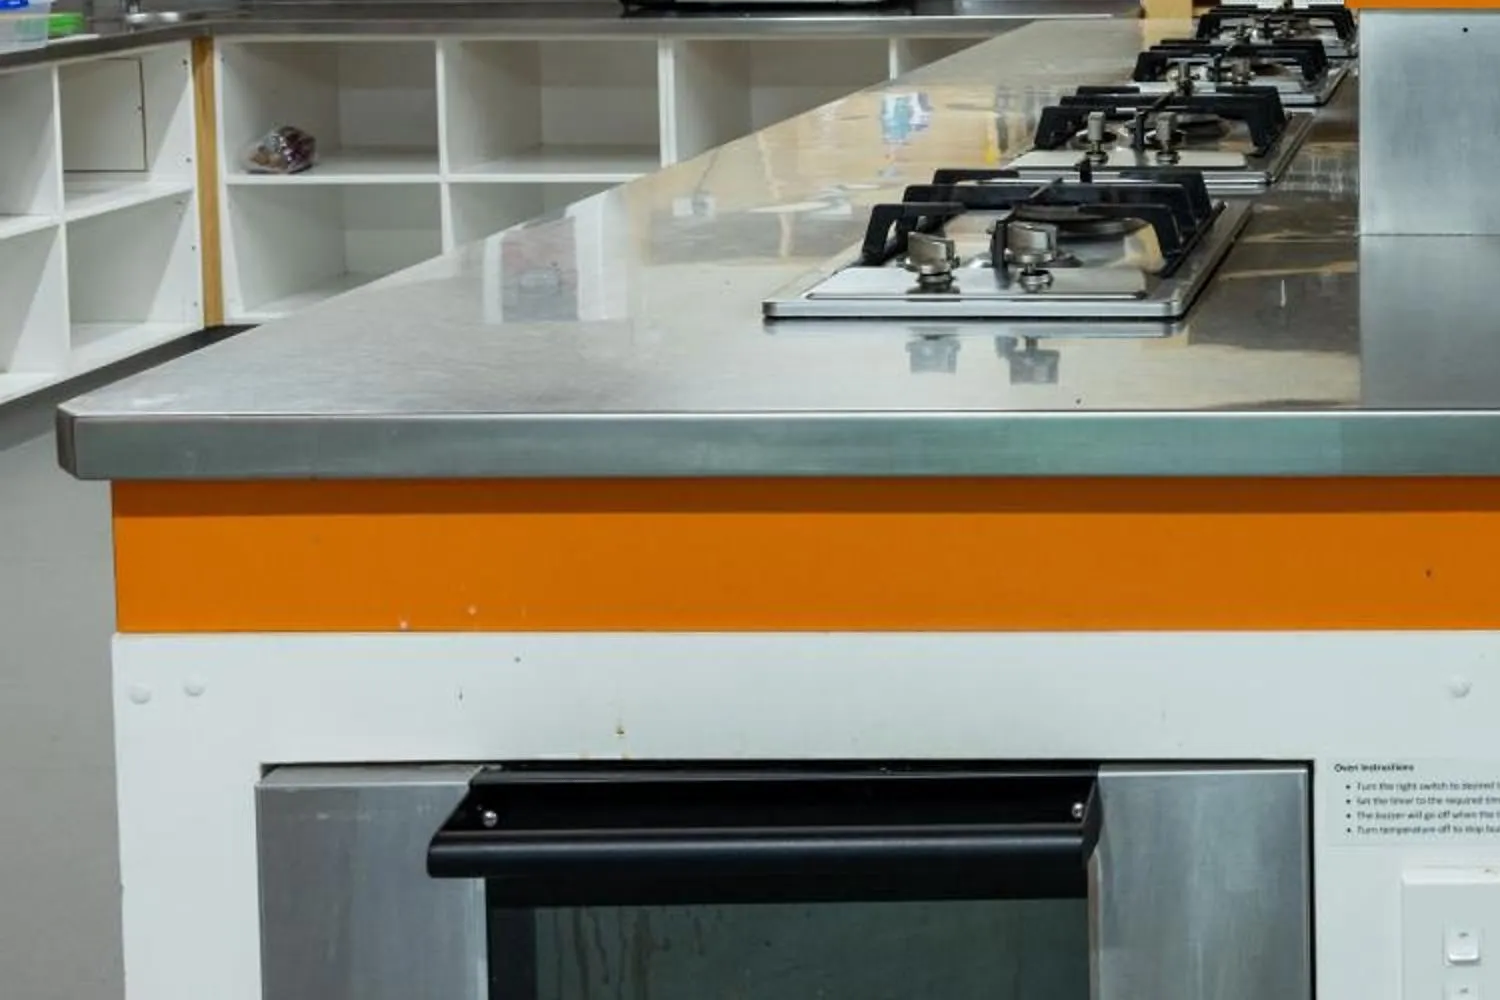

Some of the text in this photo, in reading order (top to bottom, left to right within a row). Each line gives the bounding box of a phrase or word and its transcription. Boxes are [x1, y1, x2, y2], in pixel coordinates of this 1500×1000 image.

[1333, 763, 1359, 773] Oven
[1357, 782, 1376, 791] Turn
[1379, 782, 1394, 791] the
[1396, 782, 1417, 792] right
[1419, 781, 1449, 791] switch
[1450, 781, 1460, 791] to
[1462, 781, 1495, 790] desired
[1357, 796, 1371, 805] Set
[1373, 796, 1388, 805] the
[1390, 796, 1414, 805] timer
[1415, 796, 1427, 805] to
[1428, 796, 1443, 805] the
[1445, 796, 1484, 806] required
[1357, 811, 1375, 820] The
[1408, 810, 1423, 819] will
[1424, 811, 1437, 821] go
[1438, 810, 1450, 819] off
[1451, 810, 1478, 819] when
[1479, 810, 1495, 819] the
[1357, 825, 1378, 834] Turn
[1379, 825, 1436, 835] temperature
[1438, 824, 1451, 834] off
[1452, 825, 1463, 834] to
[1465, 825, 1484, 835] stop
